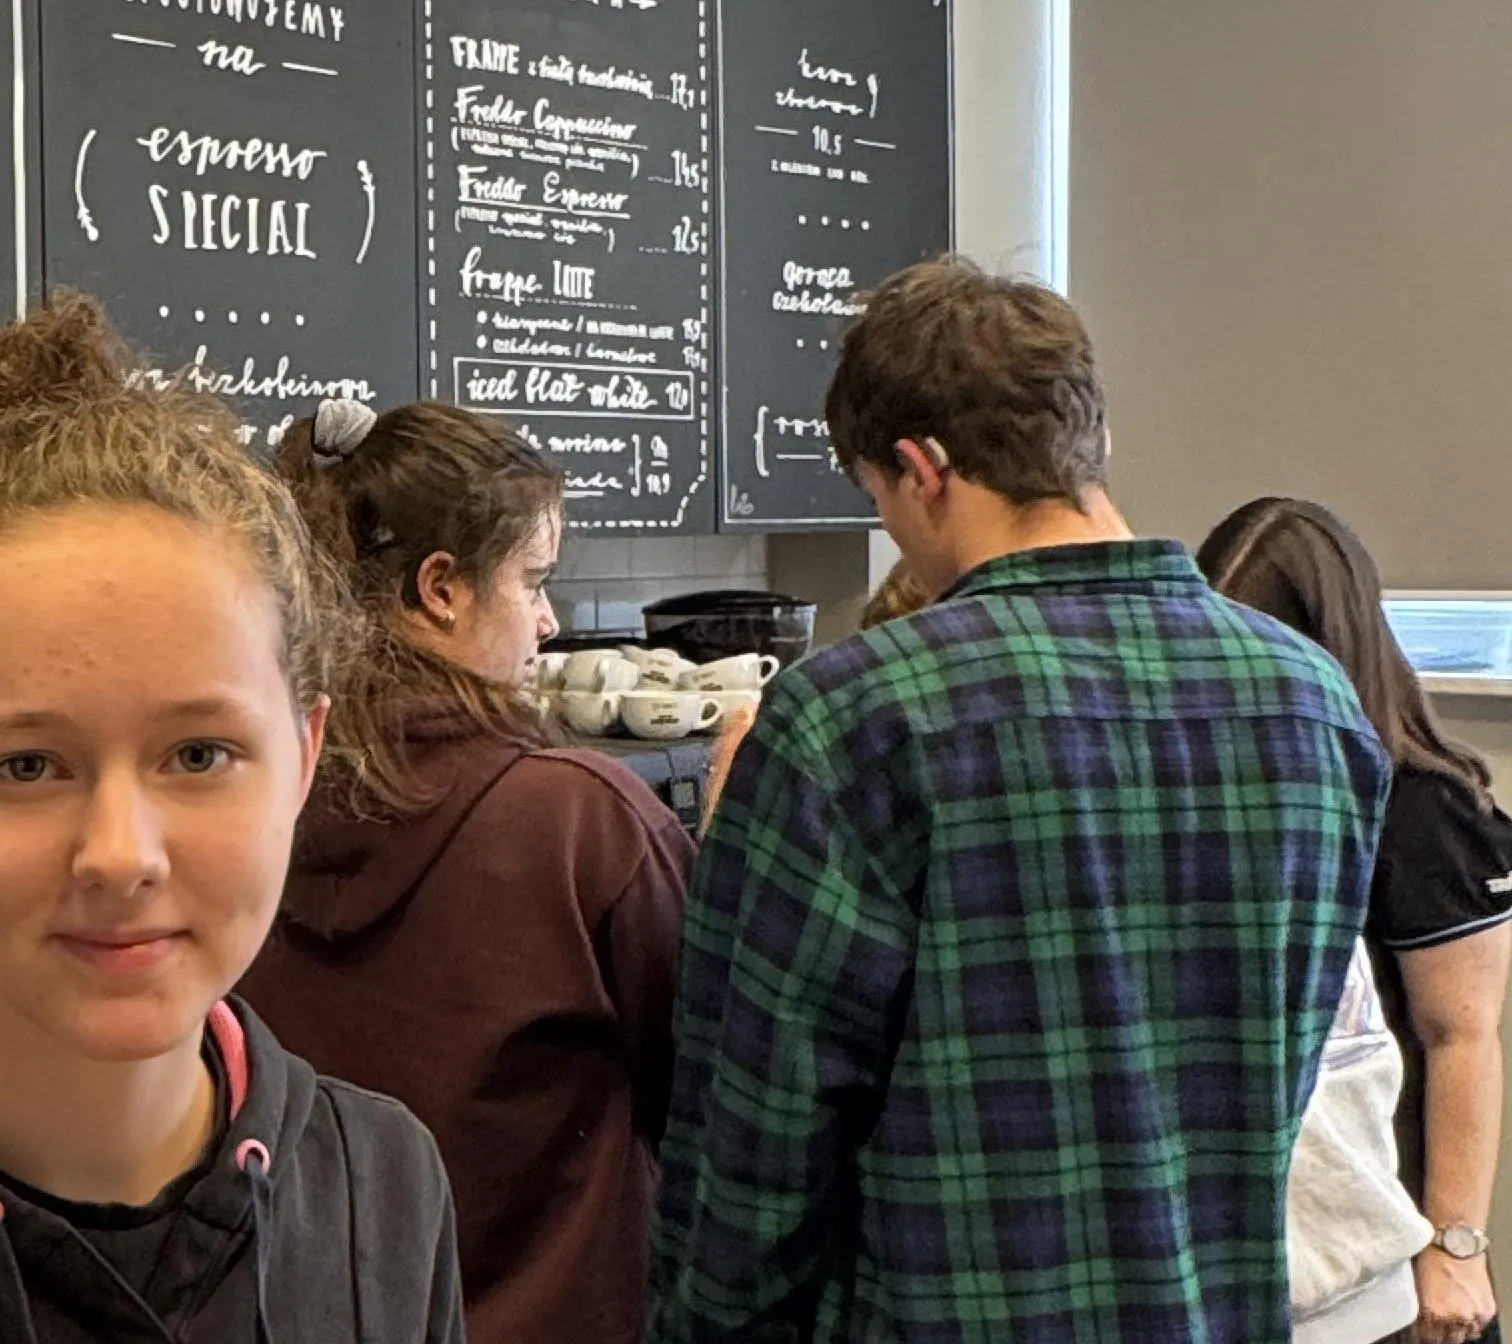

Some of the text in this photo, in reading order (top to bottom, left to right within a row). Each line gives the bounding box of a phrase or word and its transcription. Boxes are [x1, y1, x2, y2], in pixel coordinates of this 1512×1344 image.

[197, 40, 266, 76] na
[136, 127, 328, 180] espresso
[148, 184, 317, 259] SPECIAL
[525, 367, 585, 403] flat
